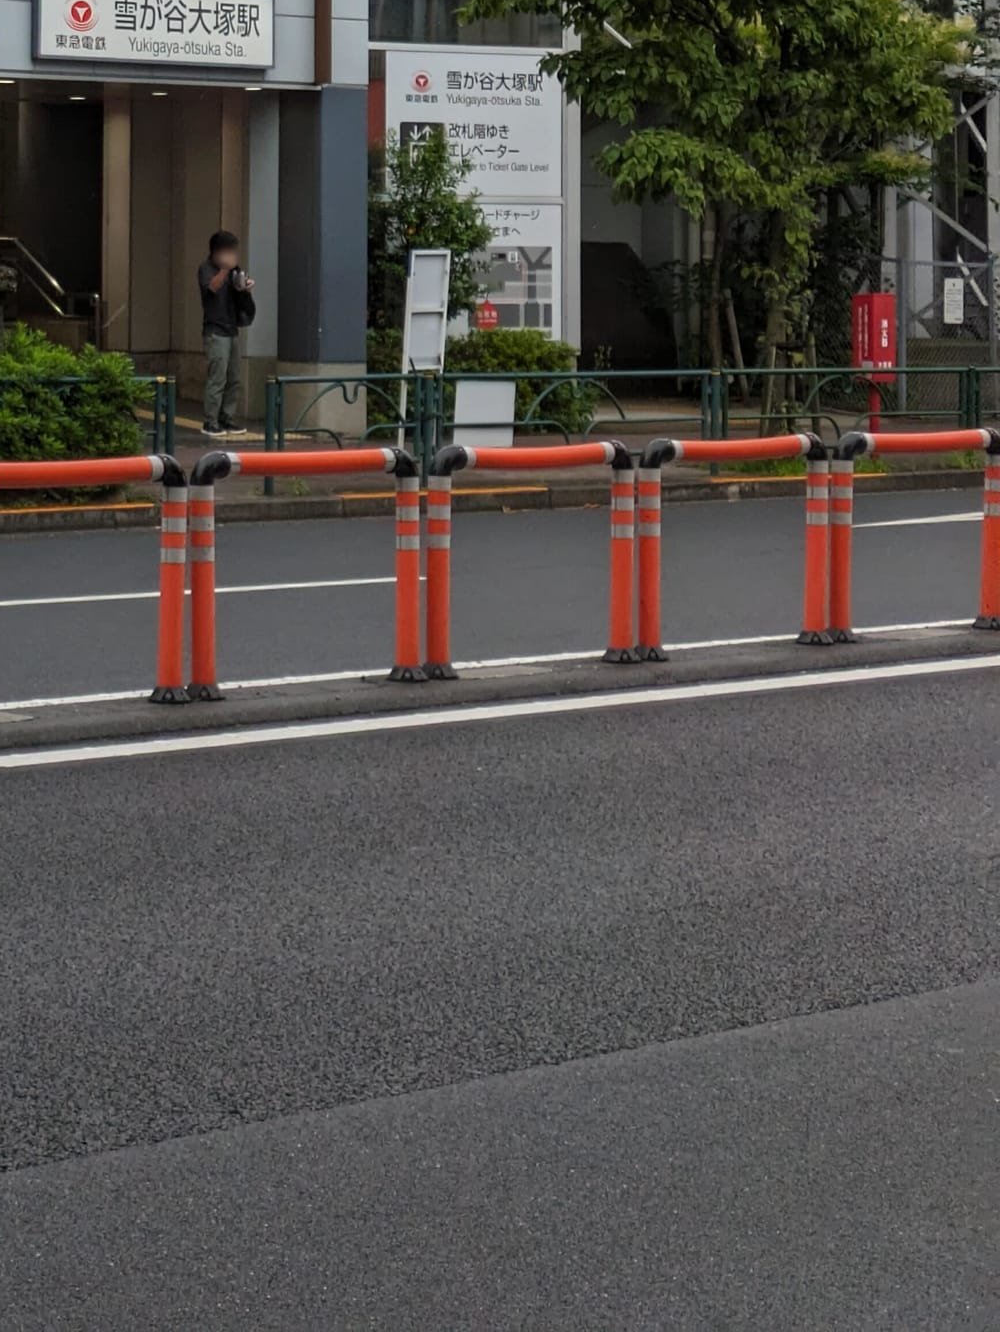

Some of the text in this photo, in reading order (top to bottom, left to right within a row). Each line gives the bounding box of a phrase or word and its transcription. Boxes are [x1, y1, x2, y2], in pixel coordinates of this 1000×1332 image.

[55, 34, 107, 51] 東急電鉄
[225, 41, 248, 58] Sta.
[446, 70, 544, 92] 雪が谷大塚駅
[524, 96, 544, 107] Sta.
[448, 123, 510, 140] 改札階ゆき
[448, 143, 520, 159] エレベーター
[510, 162, 529, 173] Gate
